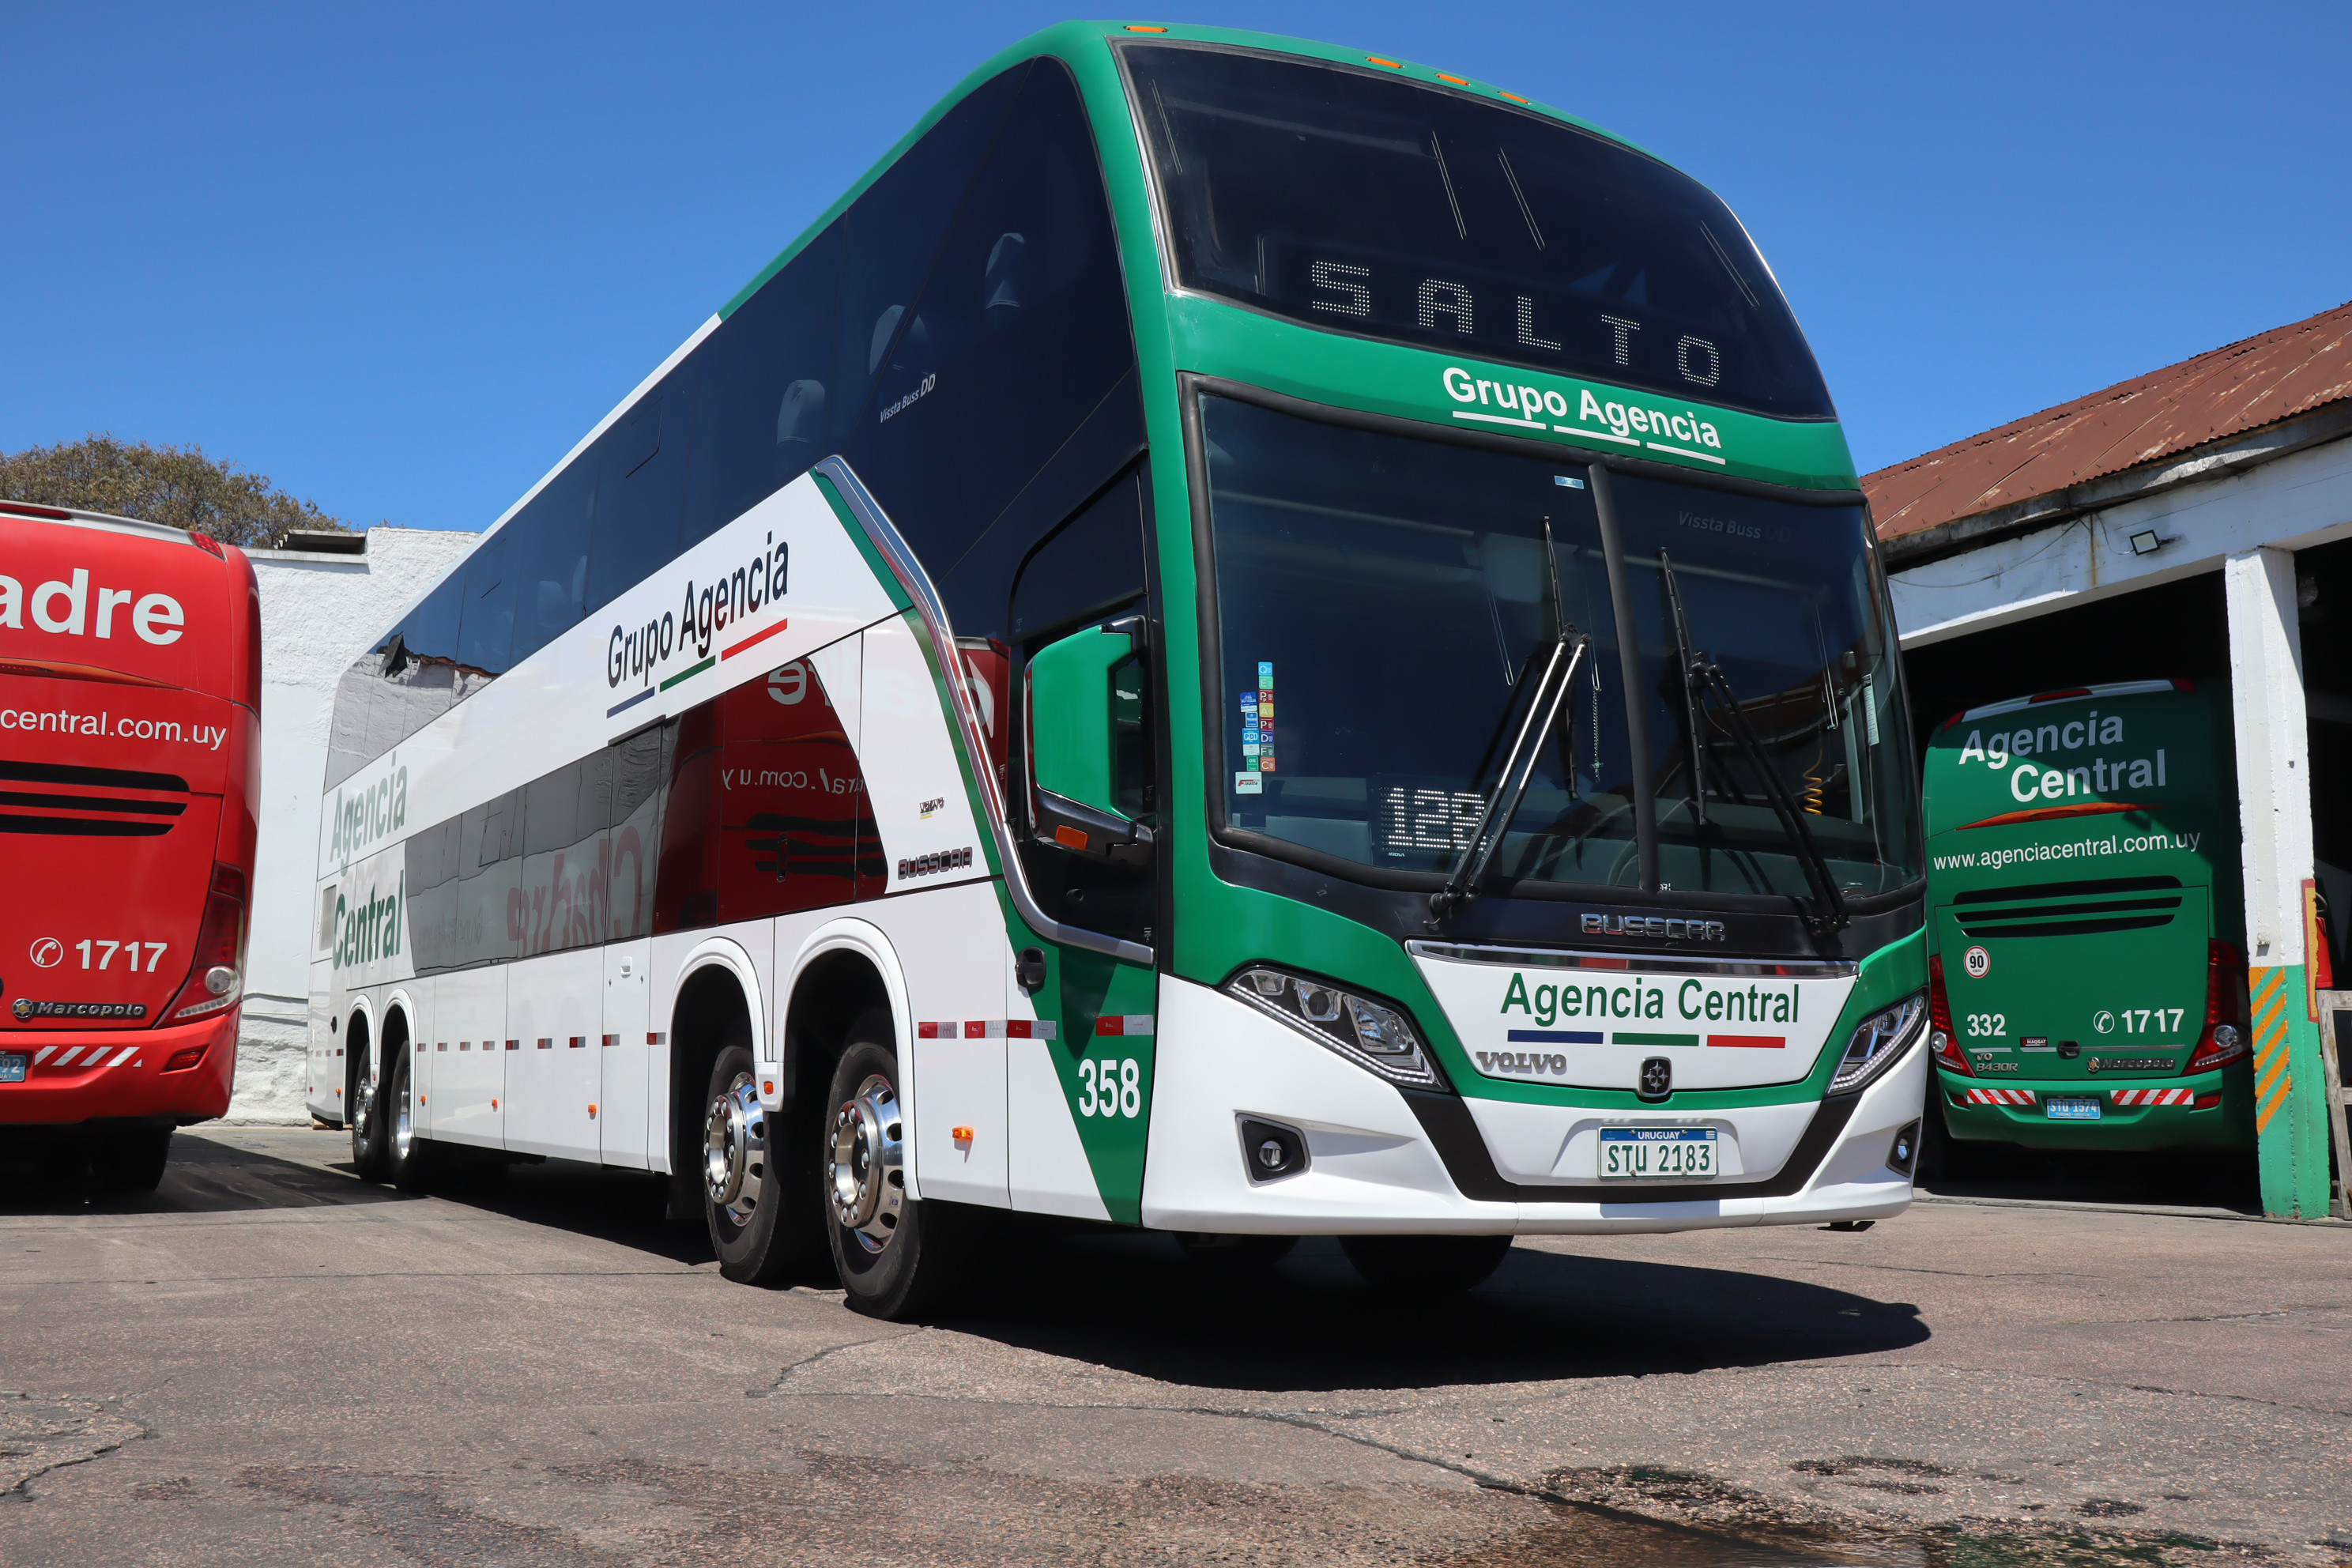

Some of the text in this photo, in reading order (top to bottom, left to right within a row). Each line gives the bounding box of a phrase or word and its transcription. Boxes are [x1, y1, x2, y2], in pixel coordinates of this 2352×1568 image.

[1311, 260, 1720, 387] SALTO
[880, 373, 936, 424] Vissta Buss DD
[1442, 367, 1722, 449] Grupo Agencia
[1678, 511, 1723, 532] Vissta
[1726, 520, 1762, 539] Buss
[607, 530, 789, 689] Grupo Agencia
[0, 709, 227, 751] central.com.uy
[1958, 711, 2124, 770] Agencia
[2010, 749, 2167, 802] Central
[329, 750, 408, 877] Agencia
[897, 846, 973, 880] BUSSCAR
[1933, 830, 2201, 871] www.agenciacentral.com.uy
[332, 869, 405, 971] Central
[1581, 913, 1726, 942] BUSSCAR
[75, 938, 168, 973] 1717
[1969, 955, 1984, 969] 90
[37, 1001, 144, 1016] Marcopolo
[1500, 972, 1800, 1027] Agencia Central
[1967, 1014, 2007, 1037] 332
[2121, 1008, 2185, 1034] 1717
[1476, 1051, 1566, 1074] VOLVO
[1977, 1062, 2018, 1072] B430R
[2101, 1058, 2174, 1069] Marcopolo
[1078, 1057, 1141, 1119] 358
[2050, 1100, 2098, 1114] STU 1574
[1638, 1131, 1680, 1140] URUGUAY
[1608, 1144, 1710, 1172] STU 2183
